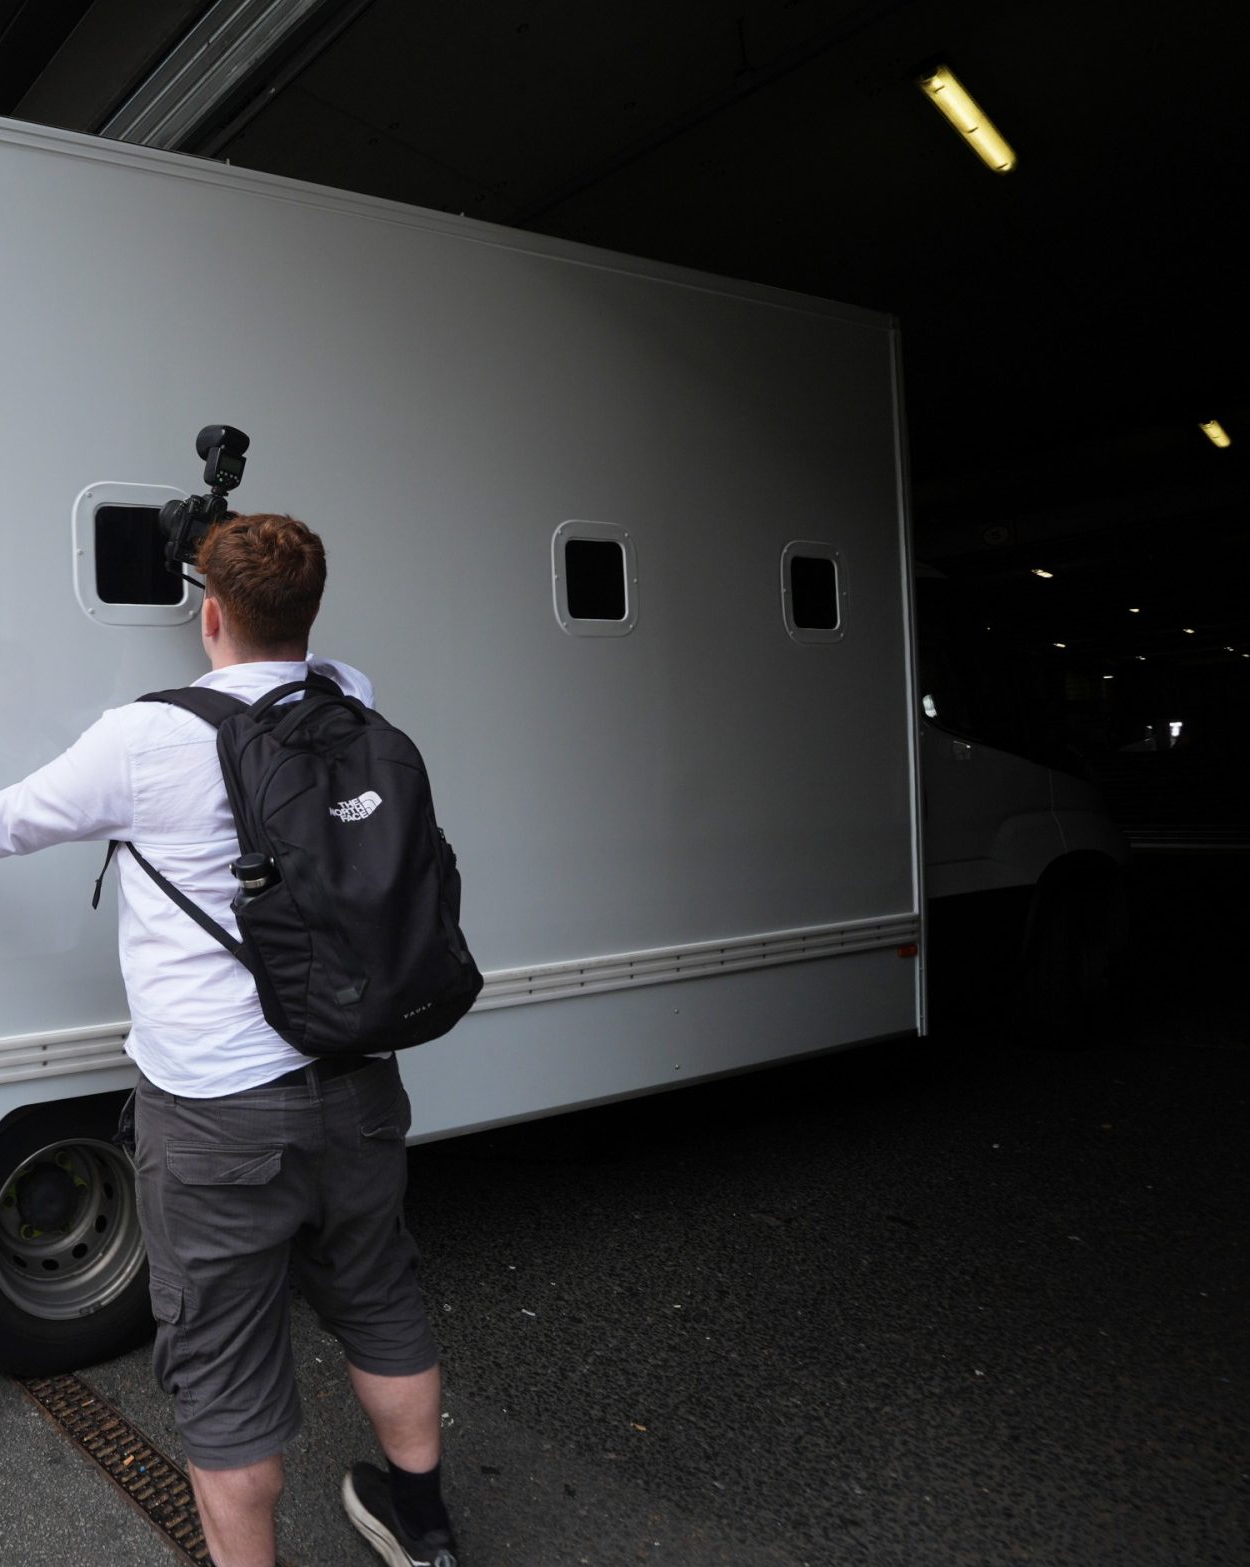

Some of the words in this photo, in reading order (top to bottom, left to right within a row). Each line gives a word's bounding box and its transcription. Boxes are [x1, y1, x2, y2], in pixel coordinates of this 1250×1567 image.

[337, 798, 361, 809] THE
[329, 803, 365, 817] NORTH
[340, 810, 369, 822] FACE
